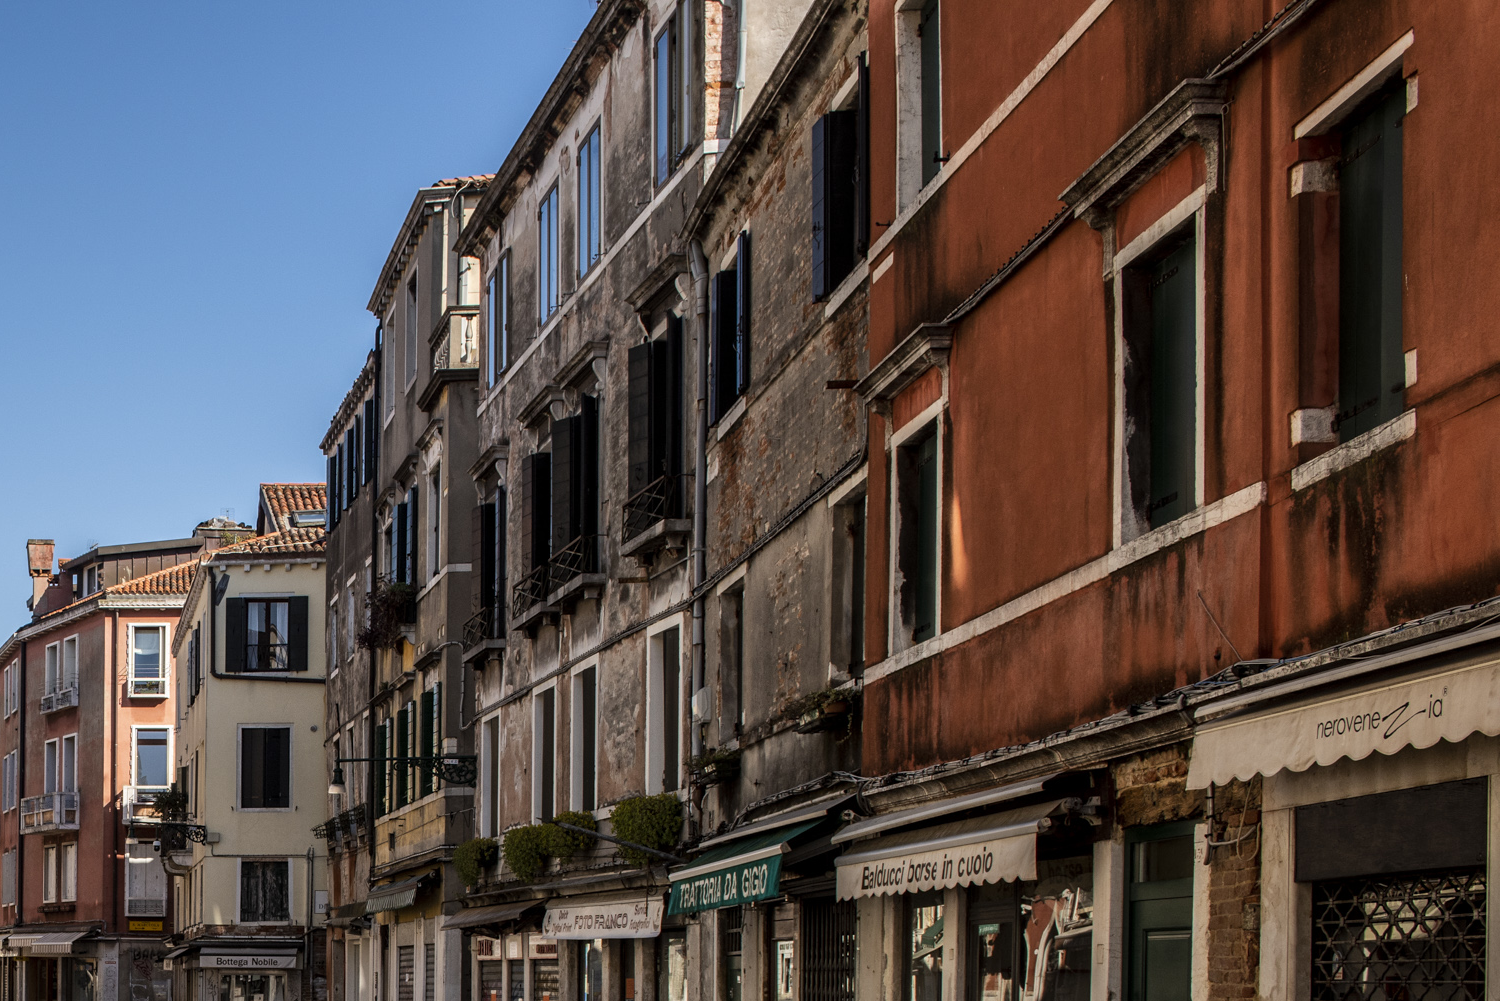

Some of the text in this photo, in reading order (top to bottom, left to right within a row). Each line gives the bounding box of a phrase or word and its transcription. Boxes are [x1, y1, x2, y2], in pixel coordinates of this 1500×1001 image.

[861, 846, 993, 890] Balducci borse in cuoio
[680, 863, 768, 909] TRATTORIA DA GIGIO
[574, 912, 628, 930] FOTO FRANCO
[216, 957, 278, 967] Bottega Nobile
